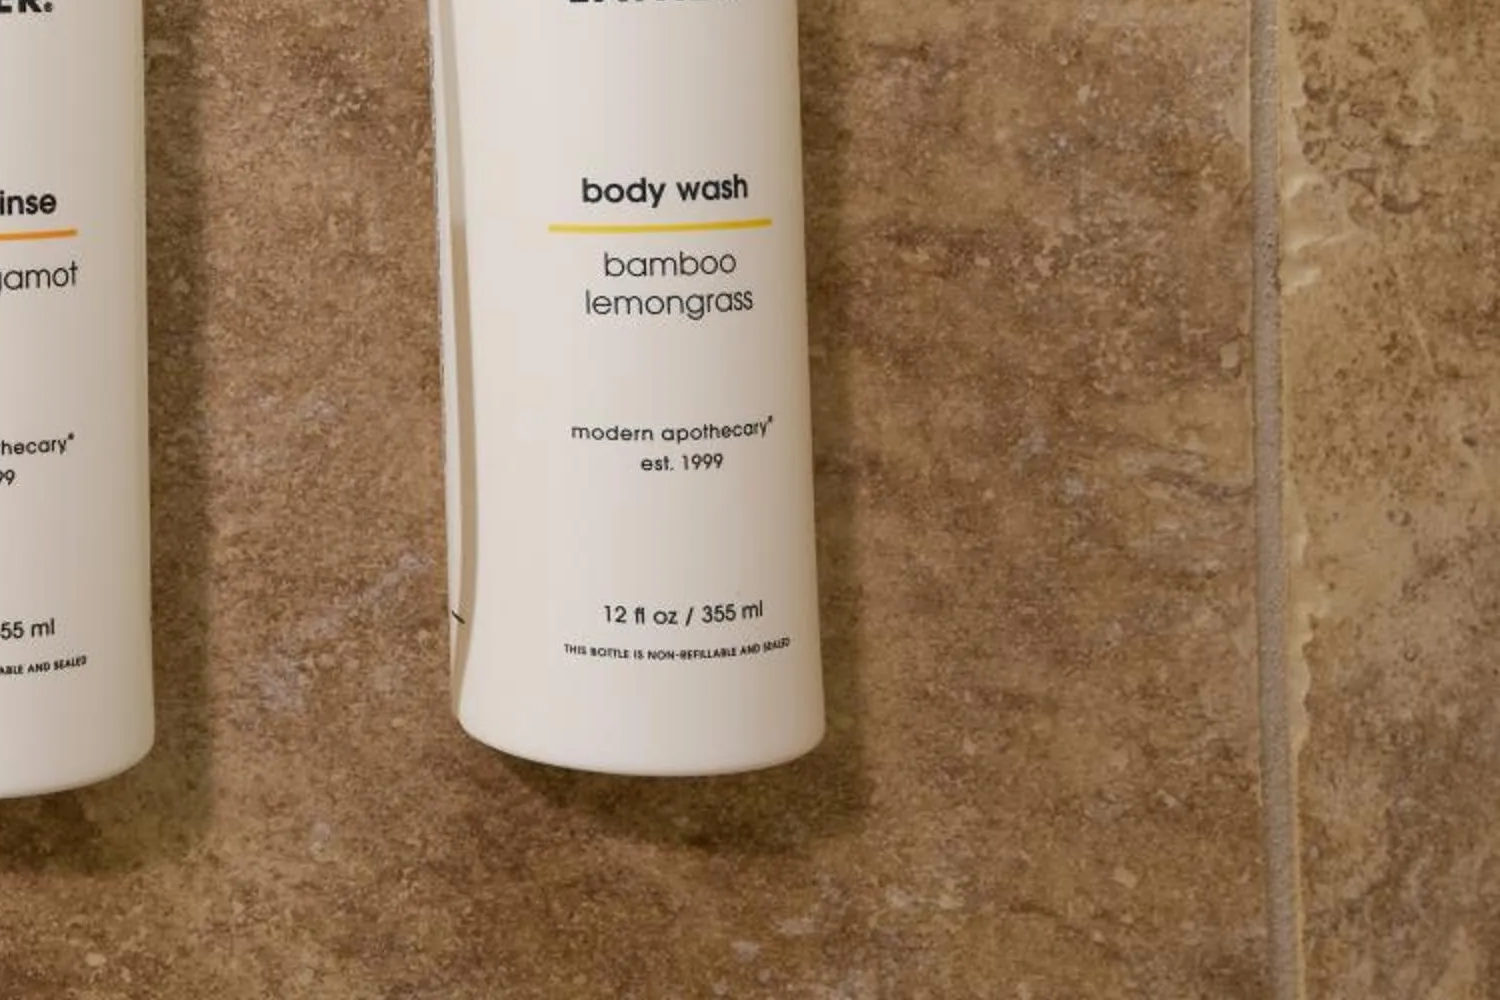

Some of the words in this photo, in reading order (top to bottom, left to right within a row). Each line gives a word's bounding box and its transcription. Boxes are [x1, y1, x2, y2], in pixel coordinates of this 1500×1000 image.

[581, 176, 667, 209] body
[675, 173, 749, 202] wash
[603, 250, 737, 278] bamboo
[585, 289, 754, 321] lemongrass
[571, 425, 655, 442] modern
[640, 455, 675, 472] est.
[681, 452, 725, 471] 1999
[603, 604, 628, 625] 12
[633, 606, 646, 625] fl
[652, 610, 679, 626] oz
[684, 606, 695, 627] /
[701, 603, 737, 624] 355
[741, 599, 764, 620] ml
[30, 617, 56, 639] ml
[563, 643, 588, 656] THIS
[589, 646, 630, 660] BOTTLE
[646, 647, 737, 661] NON-REFILLABLE
[739, 642, 761, 656] AND
[27, 661, 51, 674] AND
[53, 654, 88, 671] SEALED
